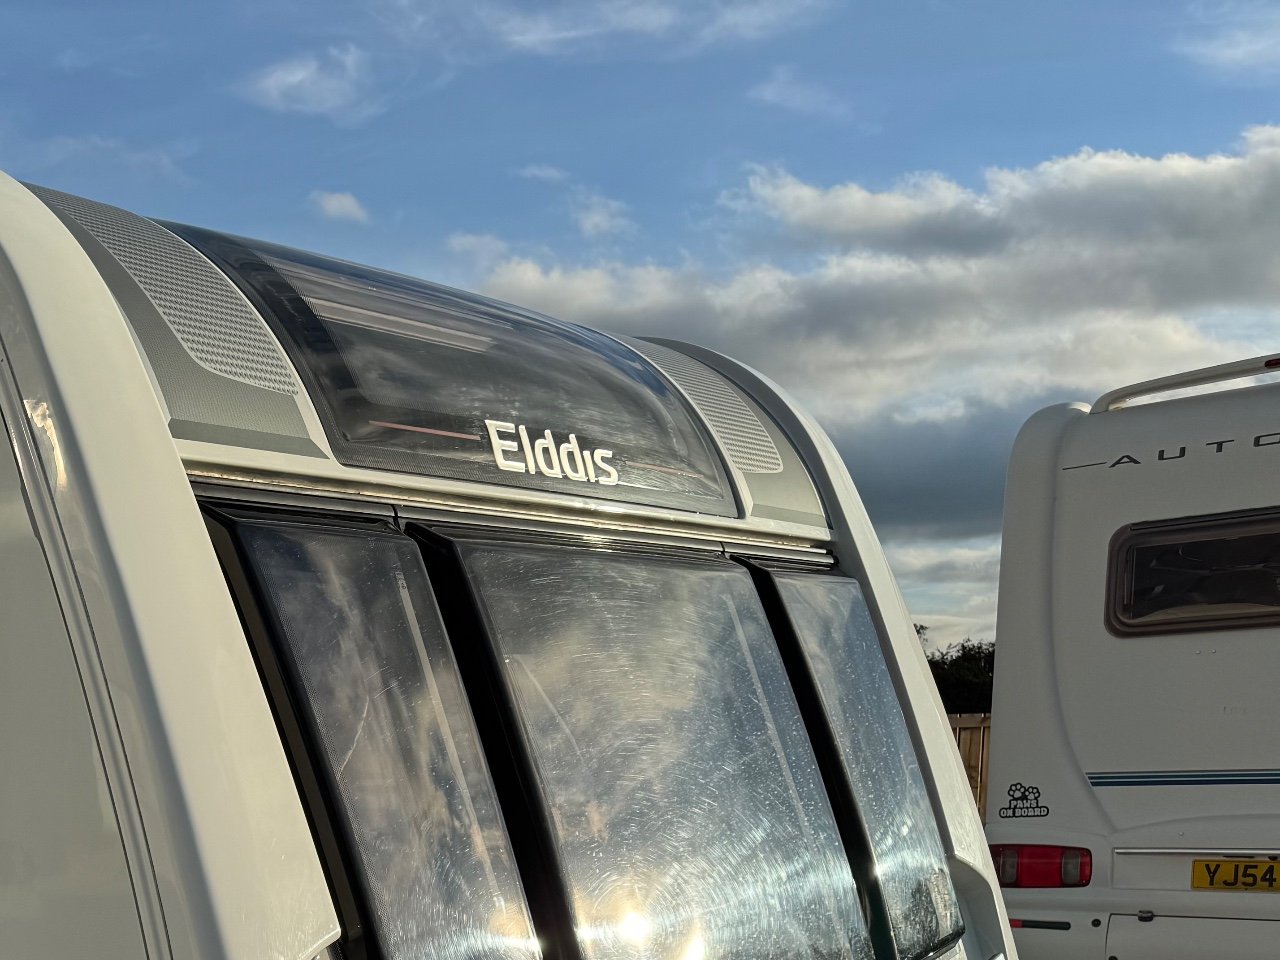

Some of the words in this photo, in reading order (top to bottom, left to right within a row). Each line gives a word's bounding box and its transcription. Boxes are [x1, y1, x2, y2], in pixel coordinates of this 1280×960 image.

[484, 419, 619, 486] Elddis
[1000, 808, 1014, 817] ON
[1014, 807, 1048, 817] BOARD
[1010, 799, 1037, 808] PAWS
[1204, 863, 1277, 888] YJ54
